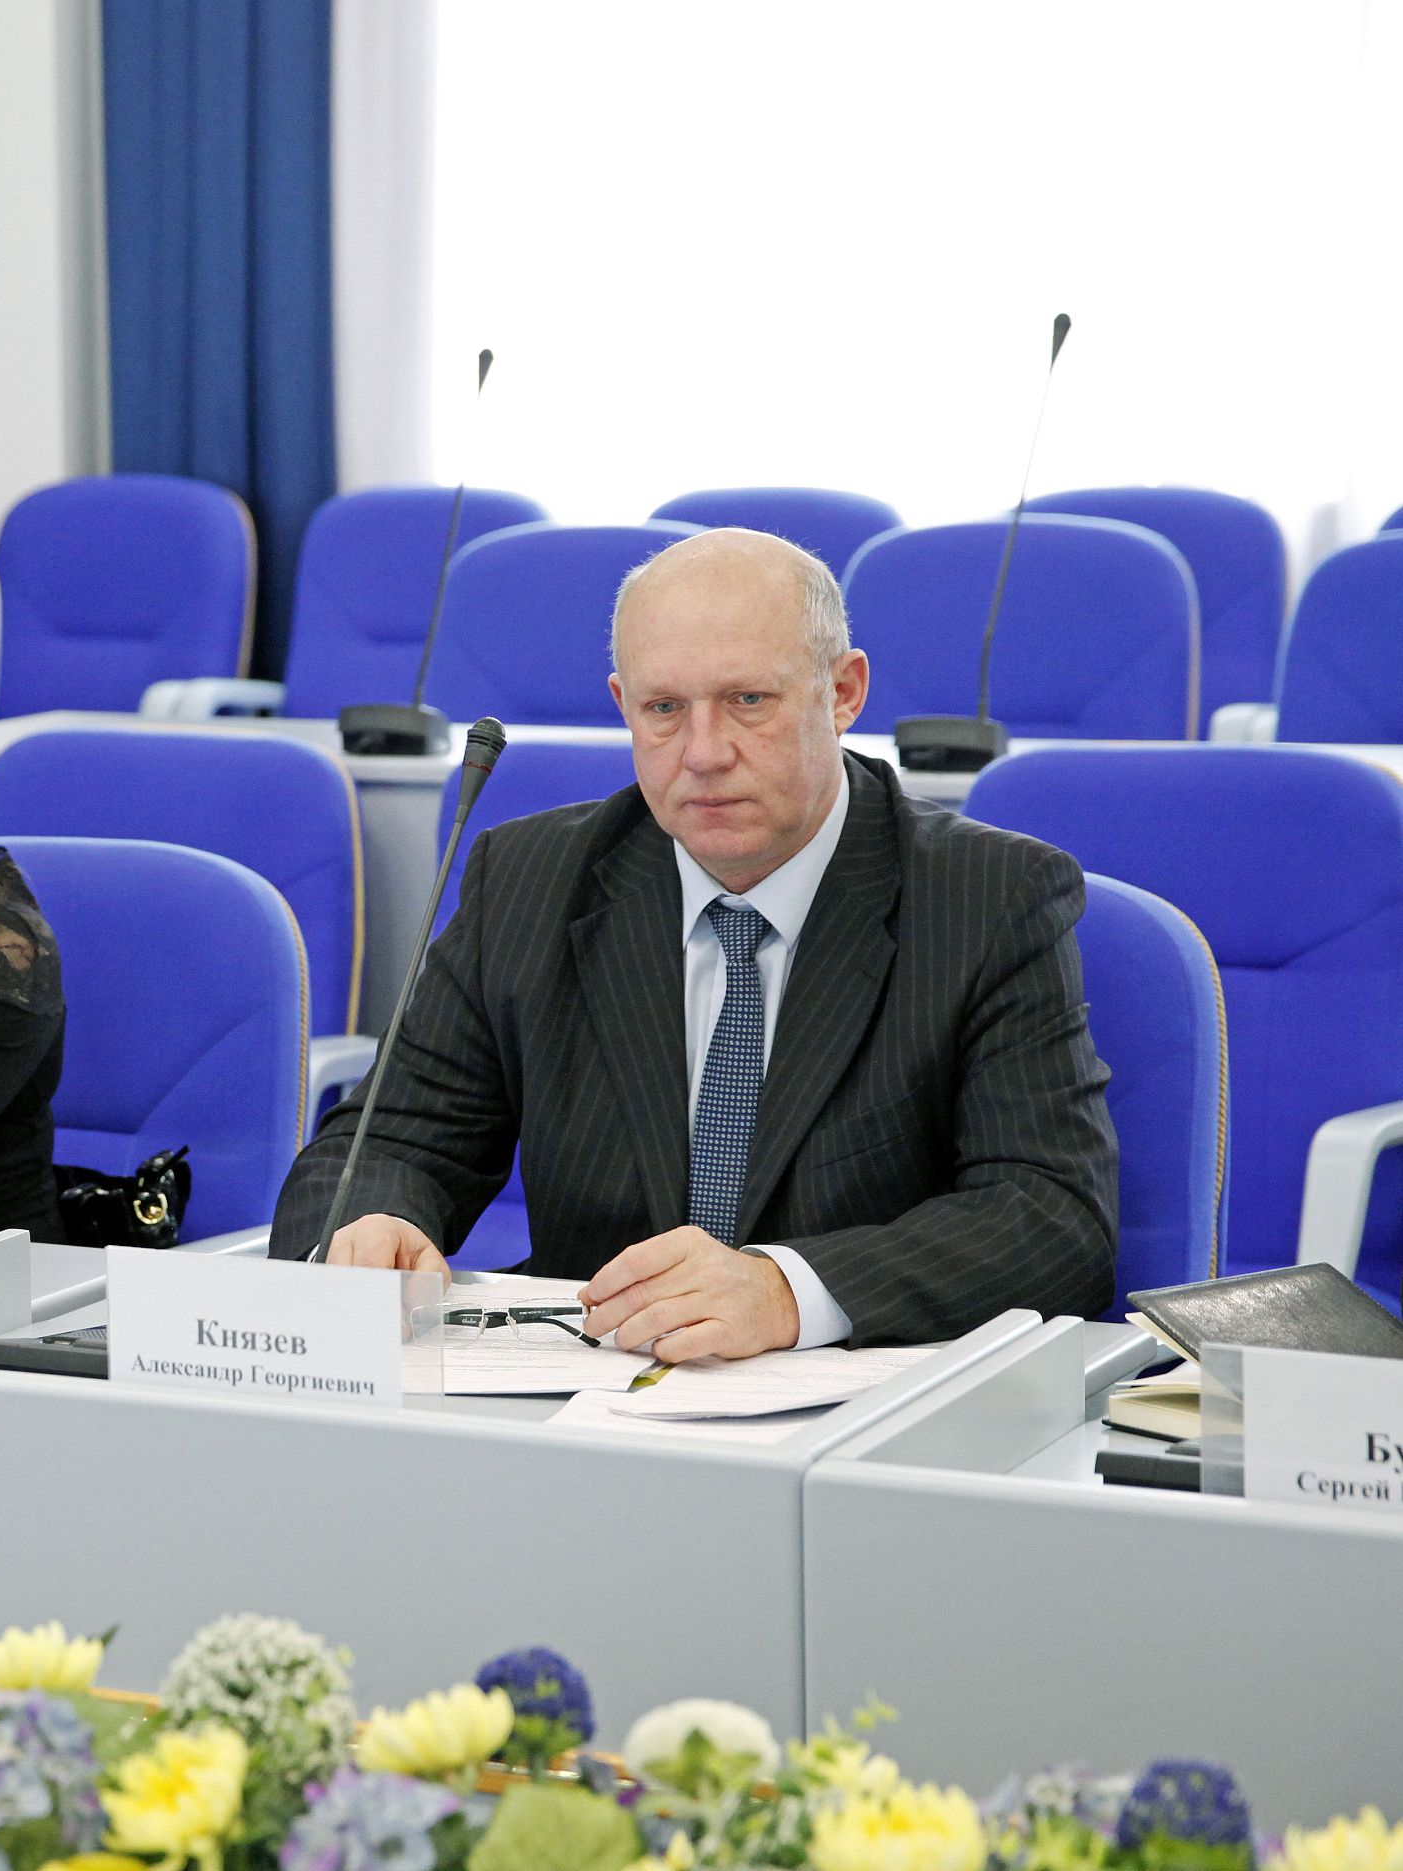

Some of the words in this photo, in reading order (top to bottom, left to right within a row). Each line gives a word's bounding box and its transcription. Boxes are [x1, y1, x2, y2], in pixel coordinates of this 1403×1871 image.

[196, 1318, 308, 1356] Князев
[131, 1354, 244, 1387] Александр
[251, 1365, 375, 1396] Георгиевич
[1296, 1471, 1390, 1501] Сергей
